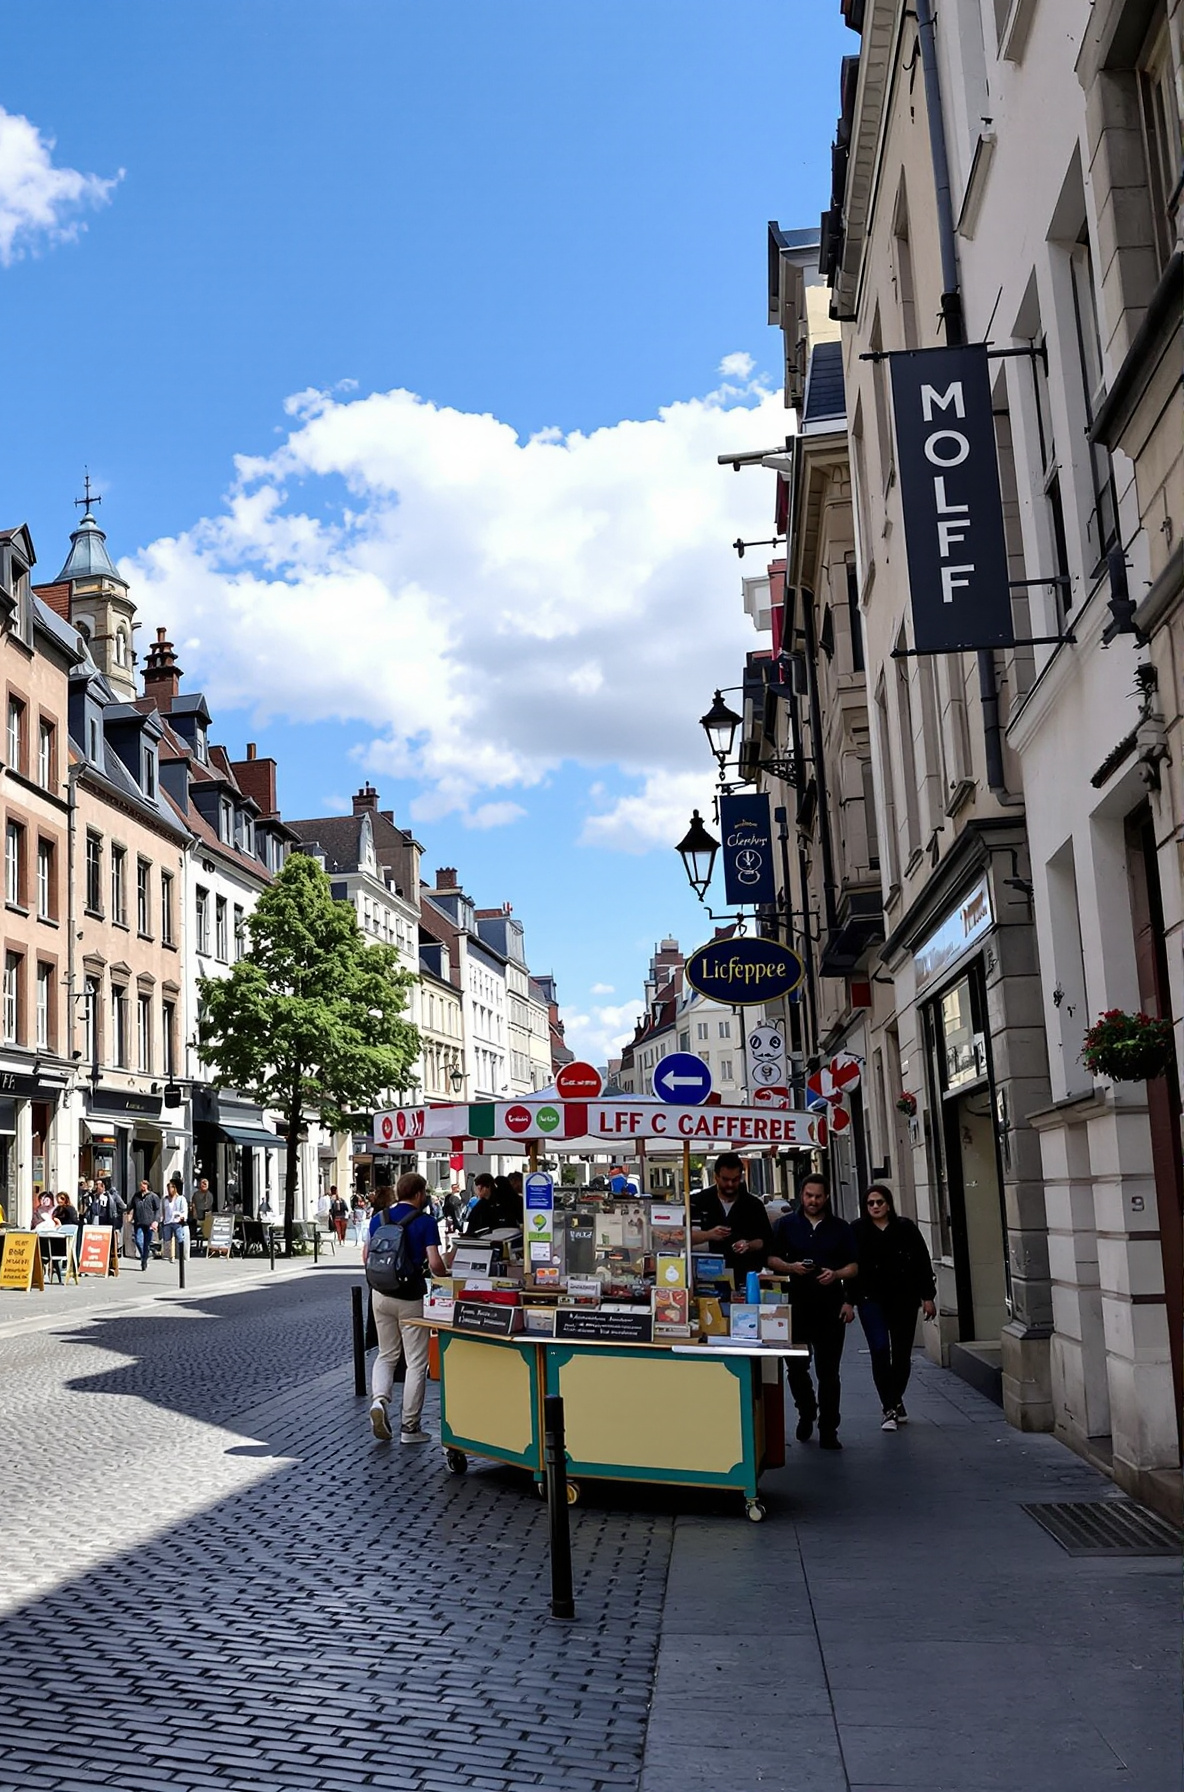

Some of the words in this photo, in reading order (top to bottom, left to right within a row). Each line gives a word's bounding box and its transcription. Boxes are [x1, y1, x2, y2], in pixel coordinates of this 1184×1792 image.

[919, 380, 976, 604] MOLFF
[599, 1112, 644, 1133] LFF
[651, 1113, 667, 1134] C
